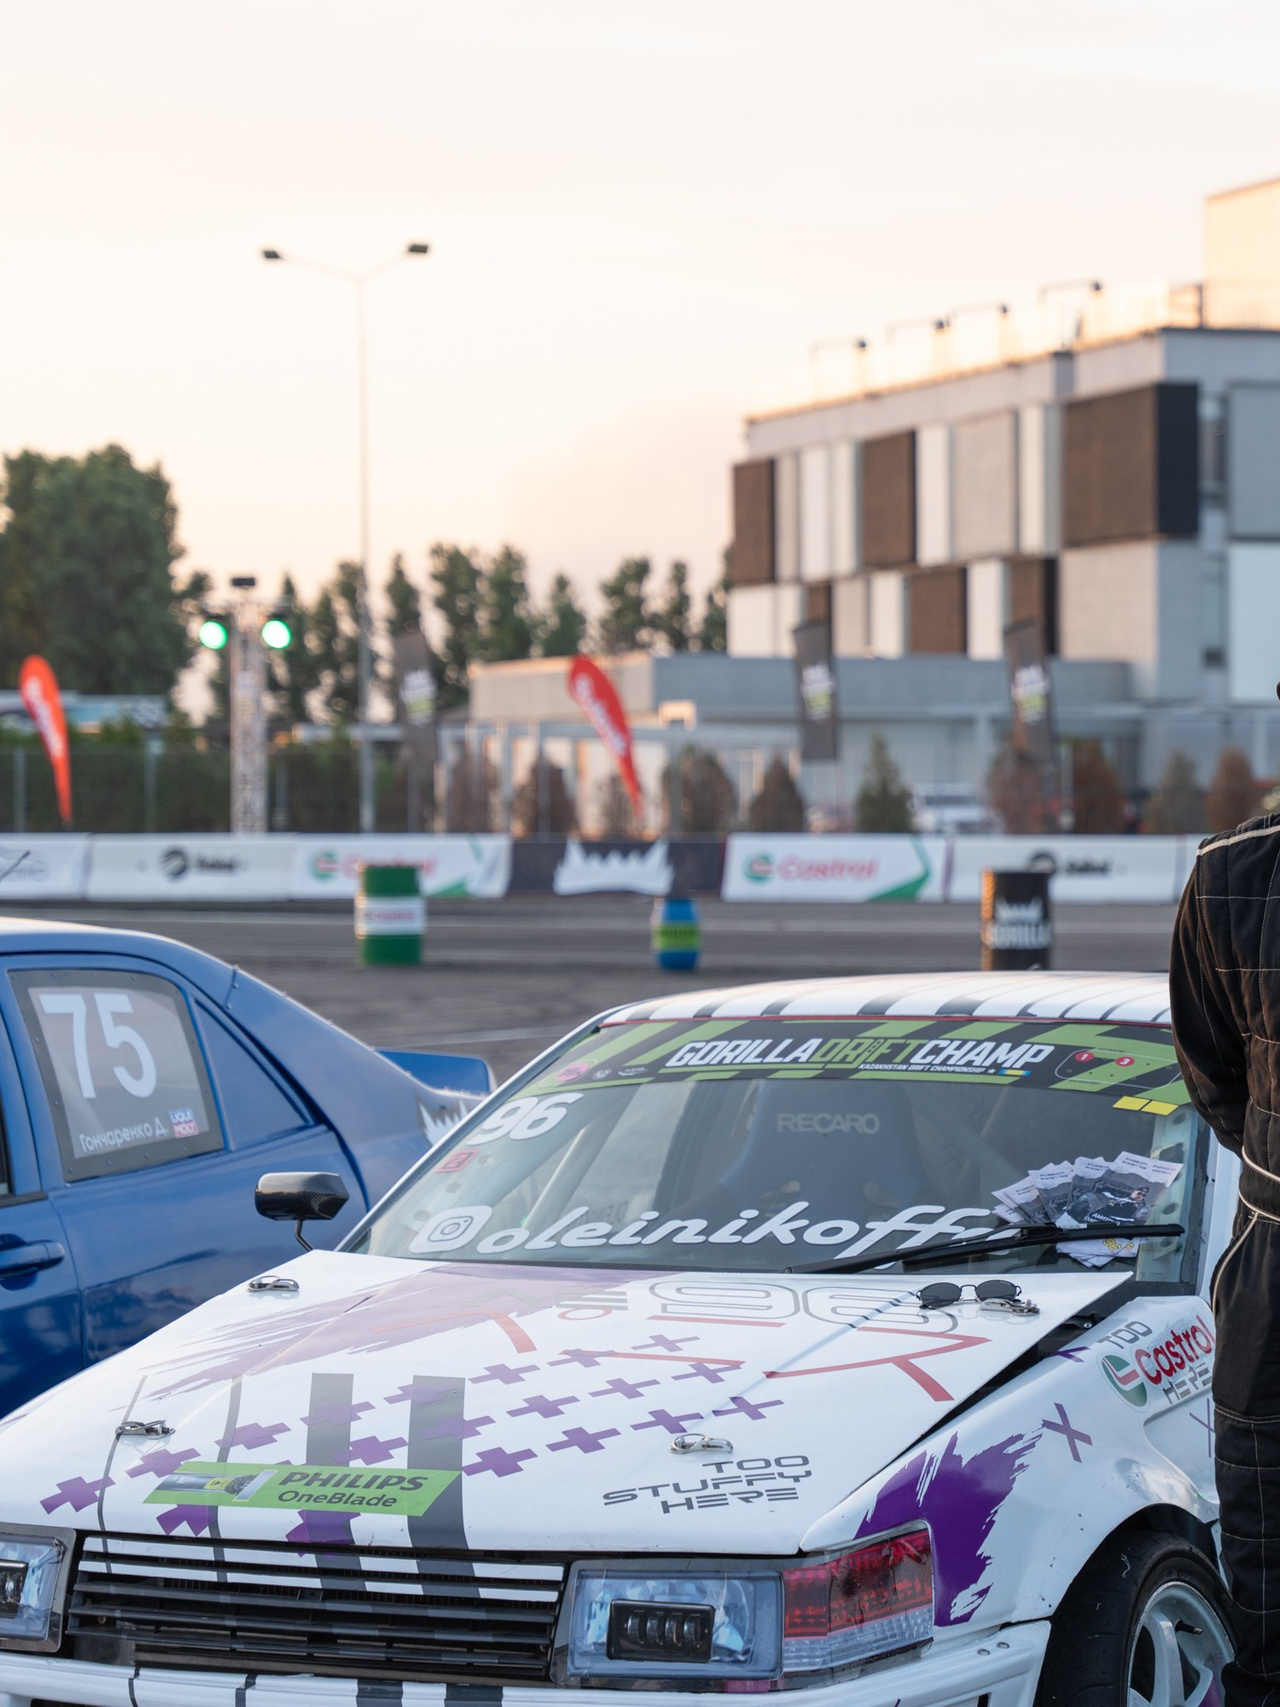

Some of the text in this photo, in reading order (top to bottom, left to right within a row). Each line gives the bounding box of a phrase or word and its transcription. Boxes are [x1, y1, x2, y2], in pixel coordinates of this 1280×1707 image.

[39, 993, 157, 1099] 75
[858, 1063, 909, 1071] KAZAKHSTAN
[908, 1064, 932, 1072] DRIFT
[467, 1092, 585, 1146] 96
[777, 1113, 880, 1135] RECARO
[80, 1123, 153, 1152] Гончаренко
[1134, 1314, 1216, 1385] Castrol
[702, 1455, 810, 1473] TOO
[278, 1471, 428, 1492] PHILIPS
[602, 1470, 812, 1506] STUFFY
[277, 1490, 398, 1507] OneBlade
[660, 1487, 799, 1514] HERE
